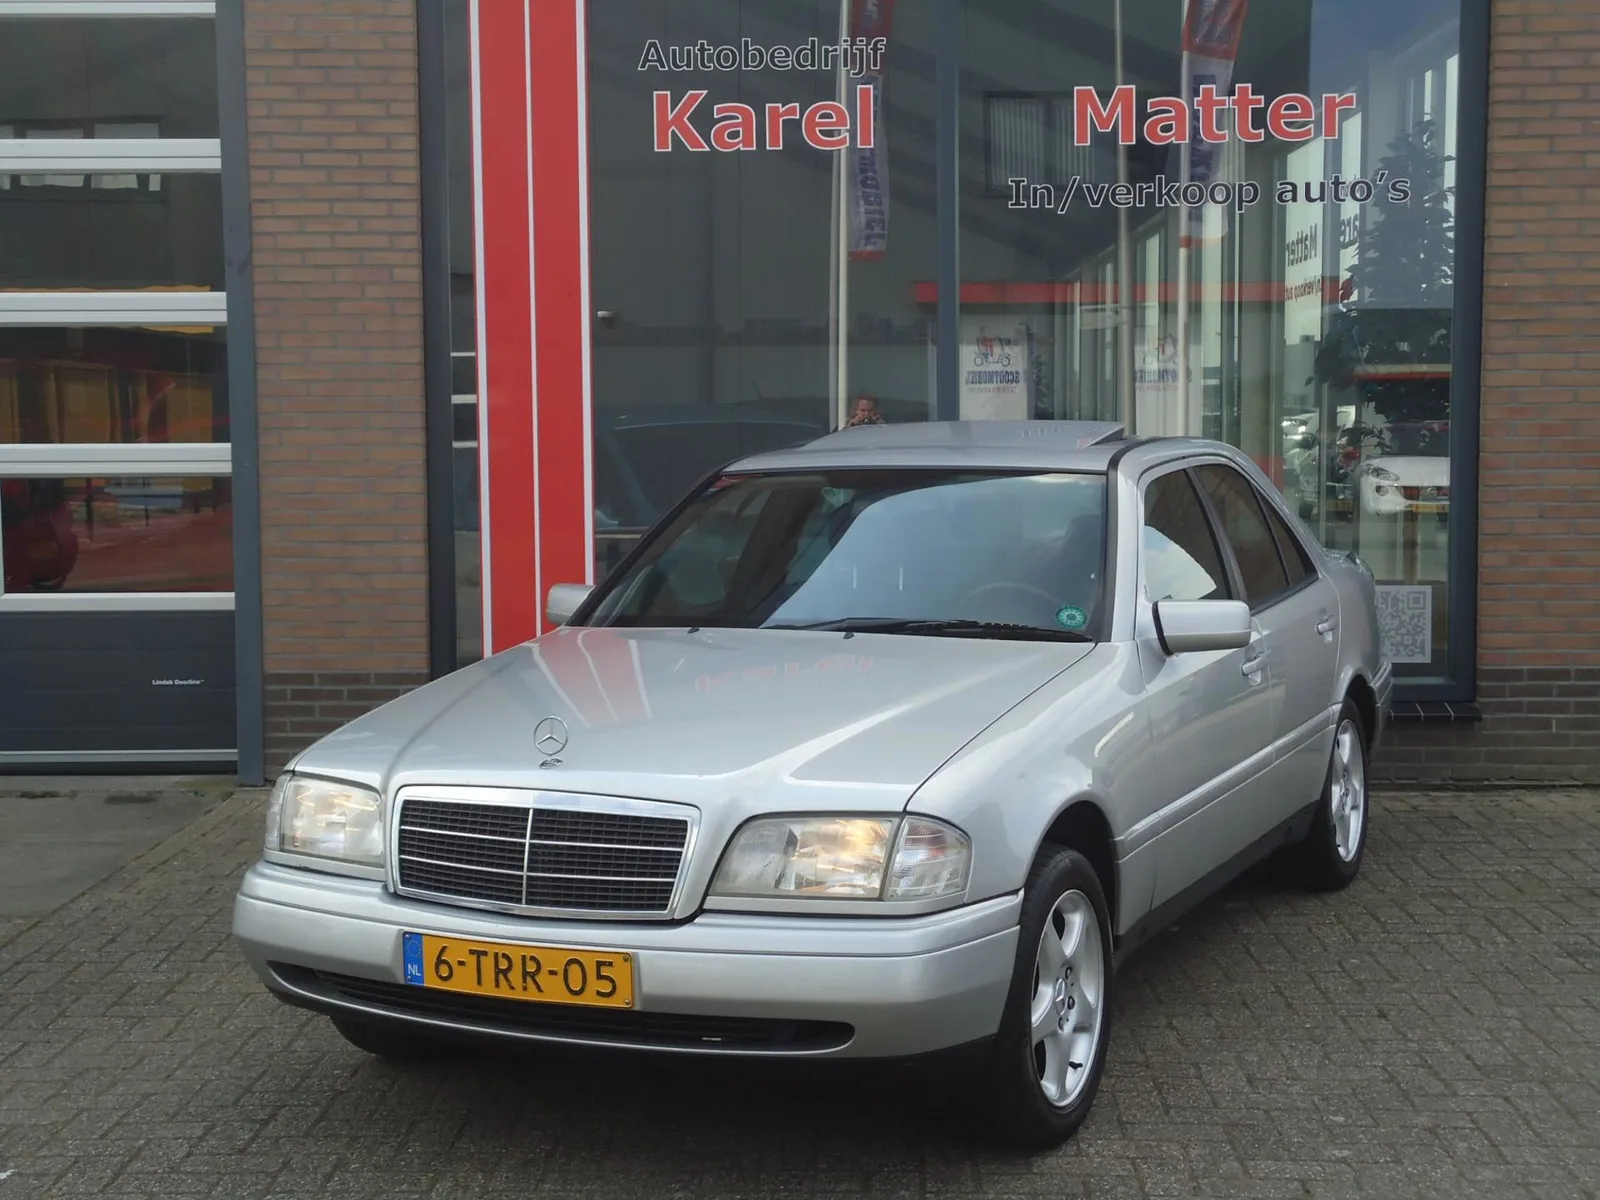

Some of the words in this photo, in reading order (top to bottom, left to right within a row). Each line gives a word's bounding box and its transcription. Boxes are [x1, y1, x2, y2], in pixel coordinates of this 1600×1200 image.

[638, 37, 887, 78] Autobedrijf
[652, 85, 875, 153] Karel
[1073, 83, 1356, 147] Matter
[1008, 174, 1260, 214] In/verkoop
[1275, 170, 1411, 205] auto's
[407, 963, 422, 977] NL
[433, 944, 618, 998] 6-TRR-05
